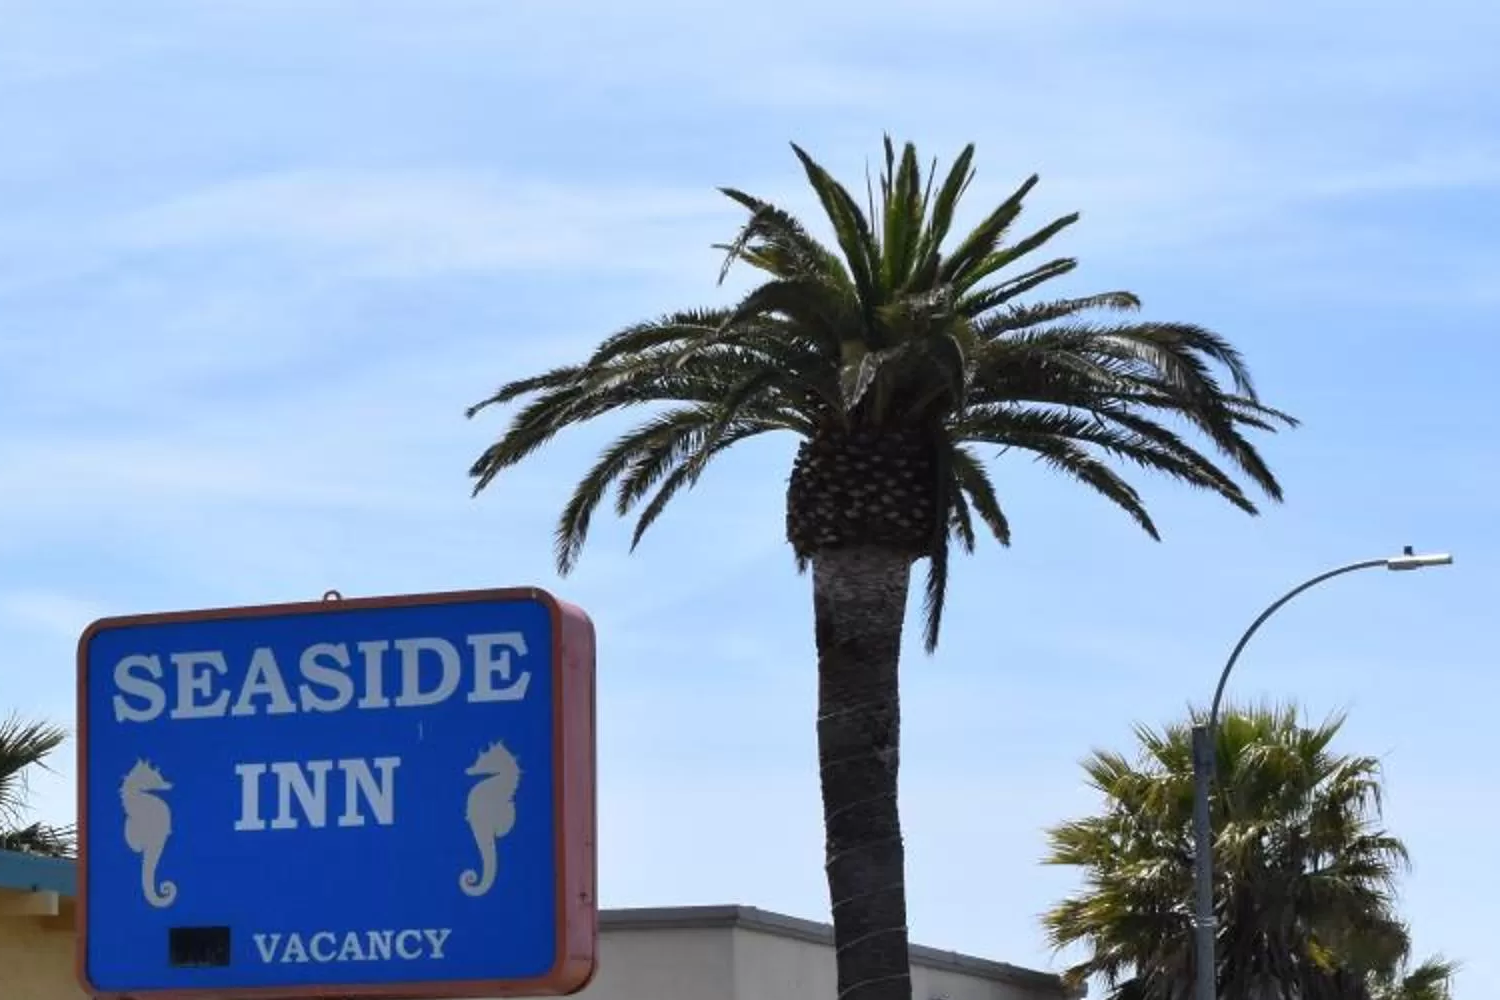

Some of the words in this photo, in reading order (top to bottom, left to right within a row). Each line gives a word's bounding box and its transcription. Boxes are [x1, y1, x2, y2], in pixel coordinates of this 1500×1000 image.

[112, 631, 532, 723] SEASIDE
[234, 756, 402, 831] INN
[253, 928, 453, 964] VACANCY
